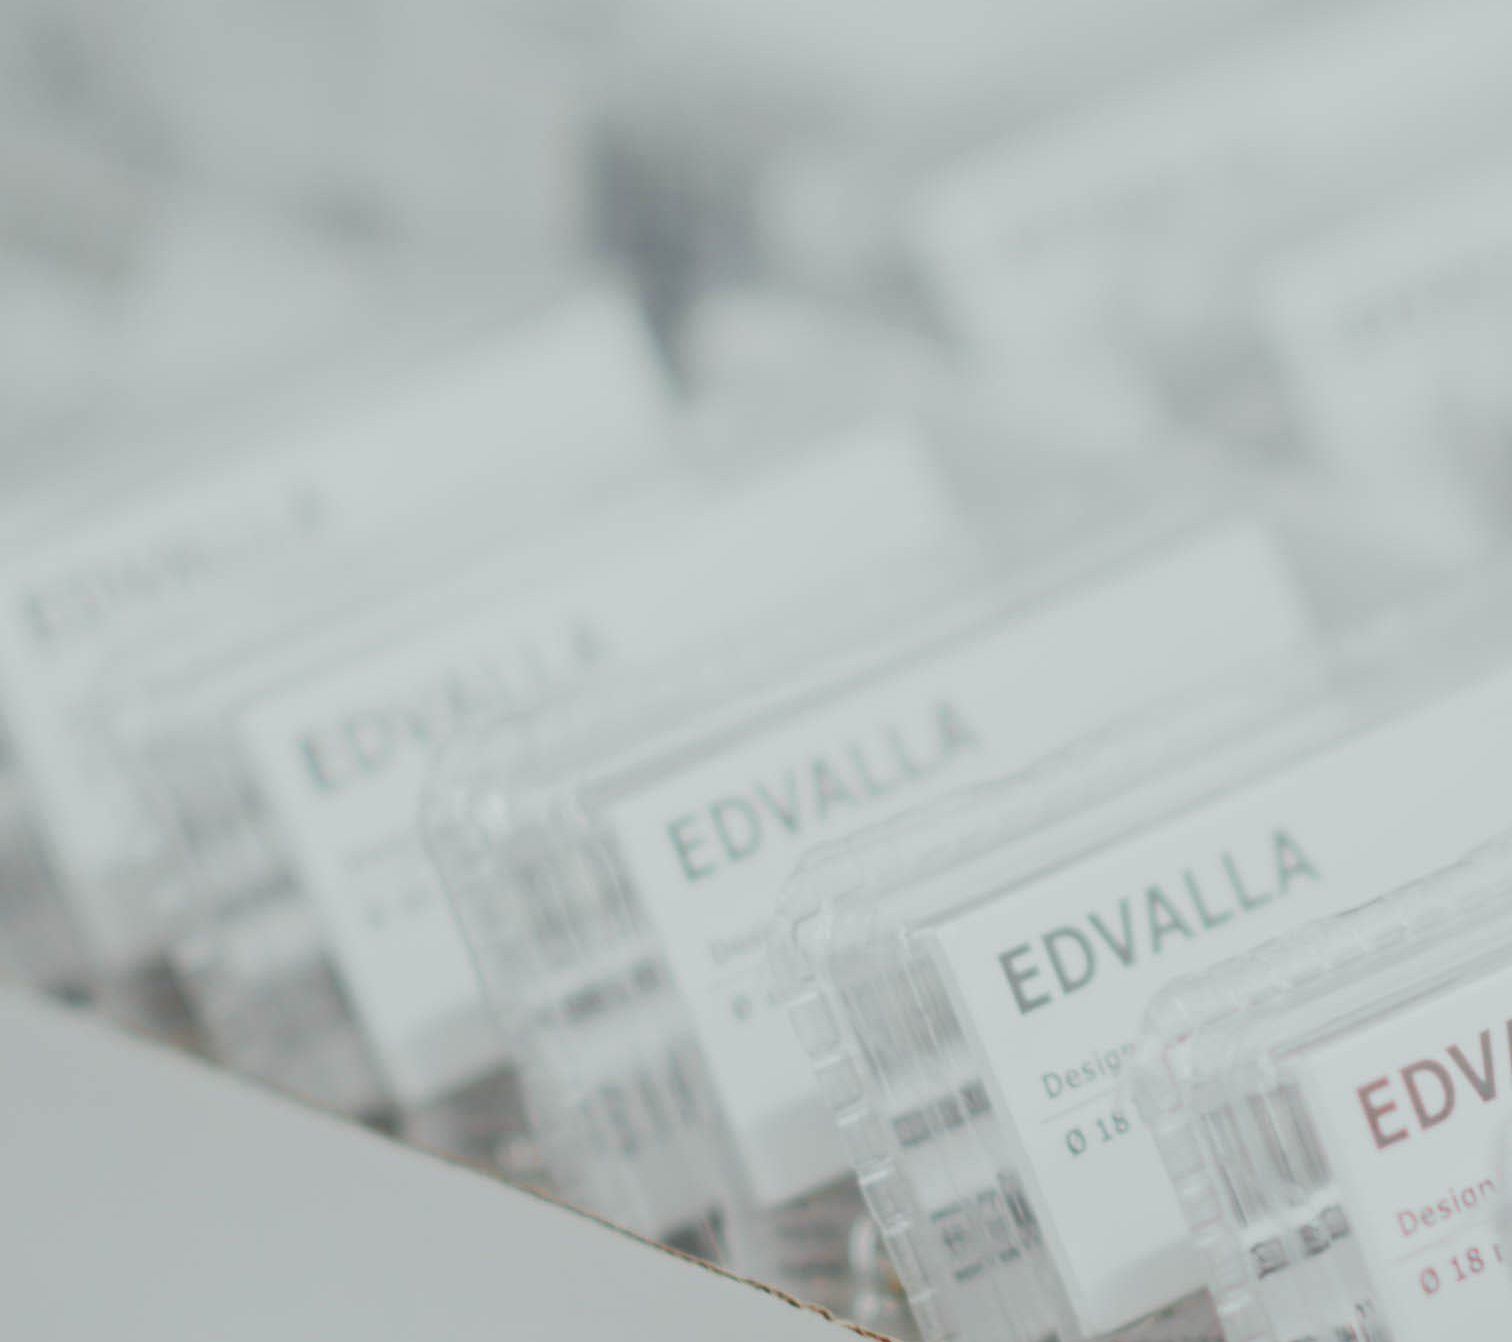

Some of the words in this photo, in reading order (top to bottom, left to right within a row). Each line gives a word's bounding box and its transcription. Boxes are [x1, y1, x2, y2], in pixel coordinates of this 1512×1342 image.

[665, 698, 984, 883] EDVALLA
[996, 825, 1322, 1017] EDVALLA
[1094, 1108, 1132, 1144] 18
[1448, 1244, 1487, 1283] 18
